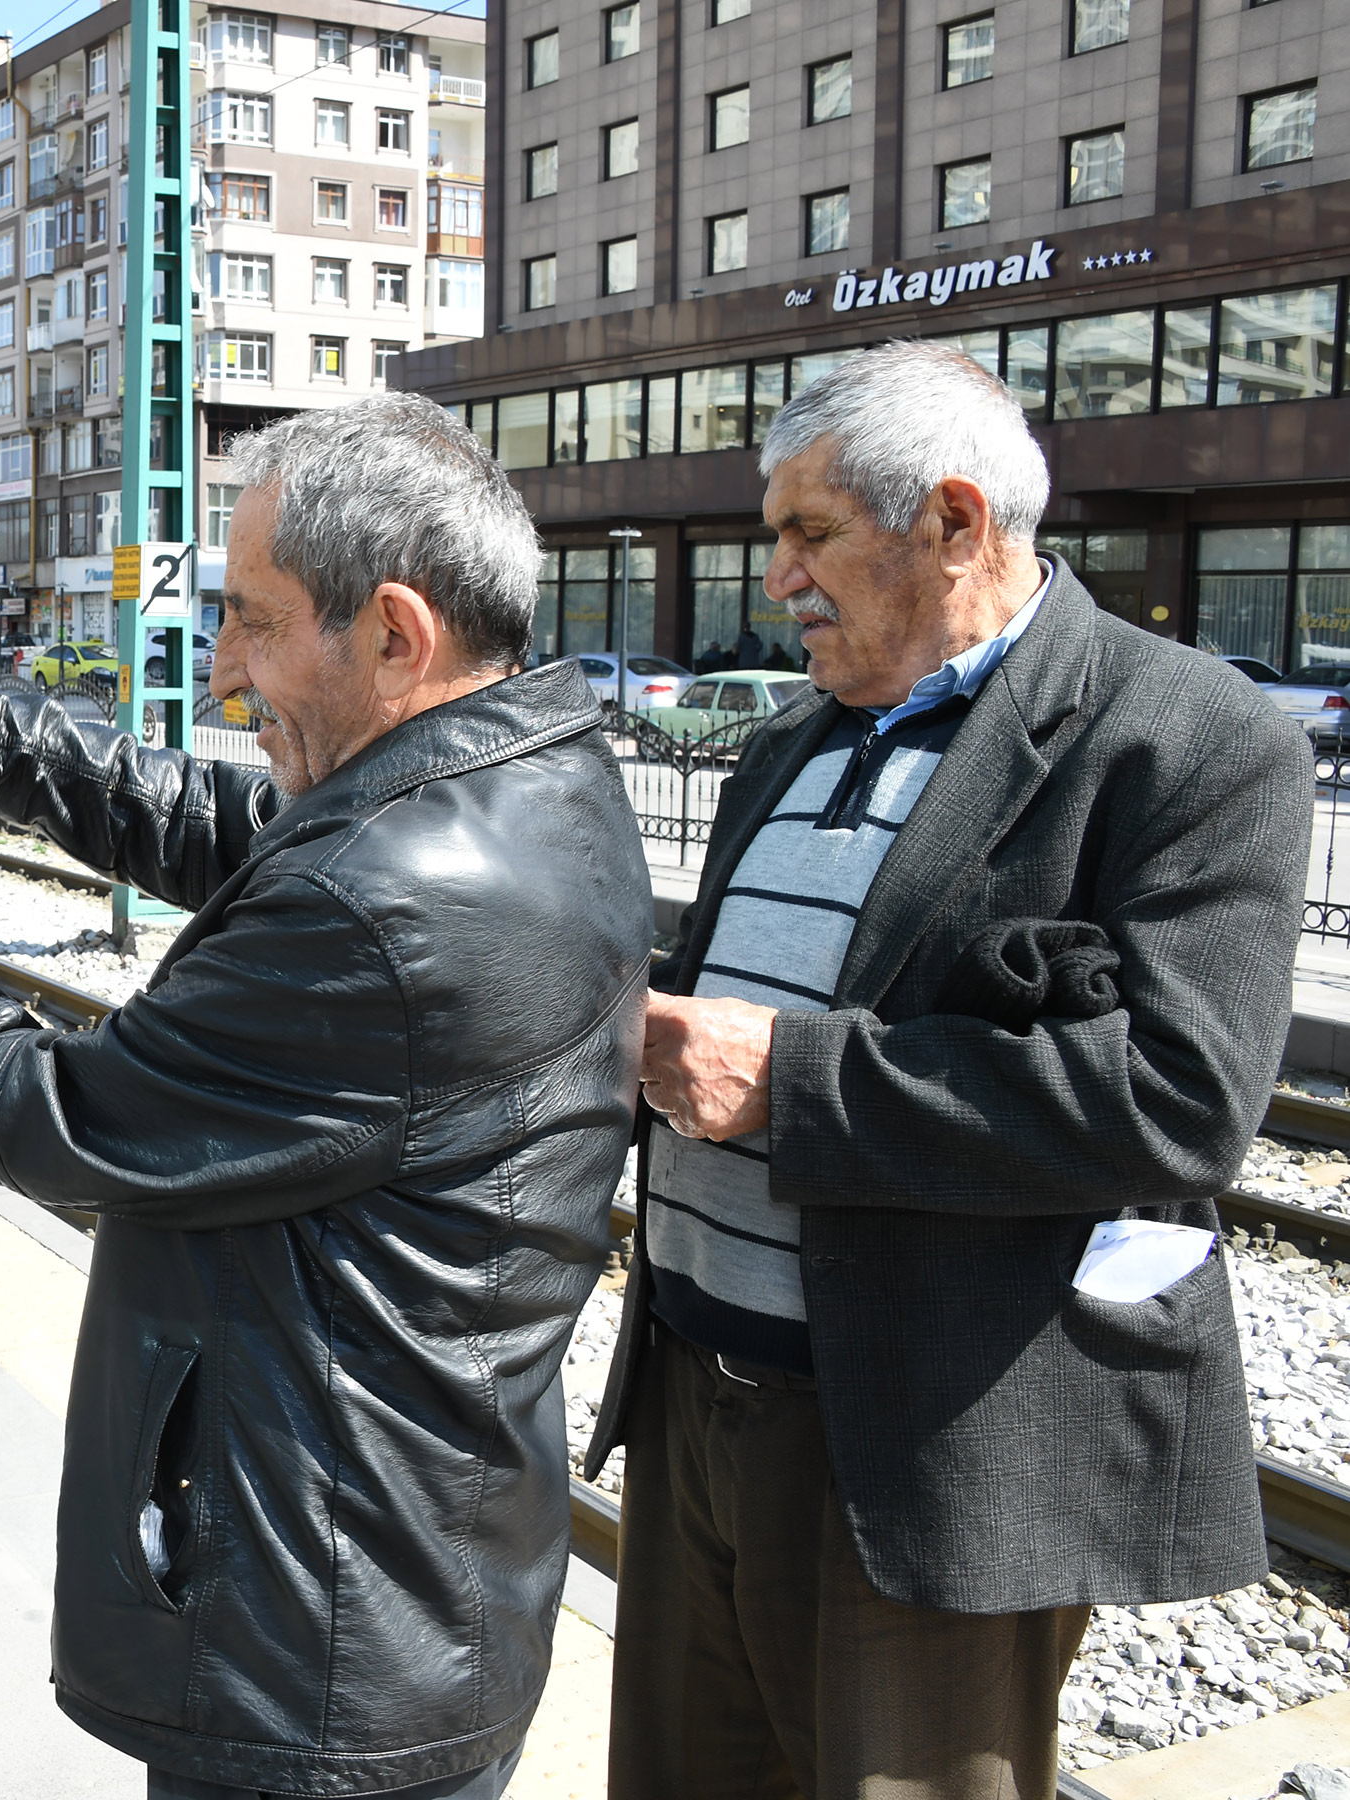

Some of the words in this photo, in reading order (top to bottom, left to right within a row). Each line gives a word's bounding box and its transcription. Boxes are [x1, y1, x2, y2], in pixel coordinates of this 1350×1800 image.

[784, 287, 813, 309] Otel
[831, 241, 1056, 313] Özkaymak
[151, 554, 181, 598] 2
